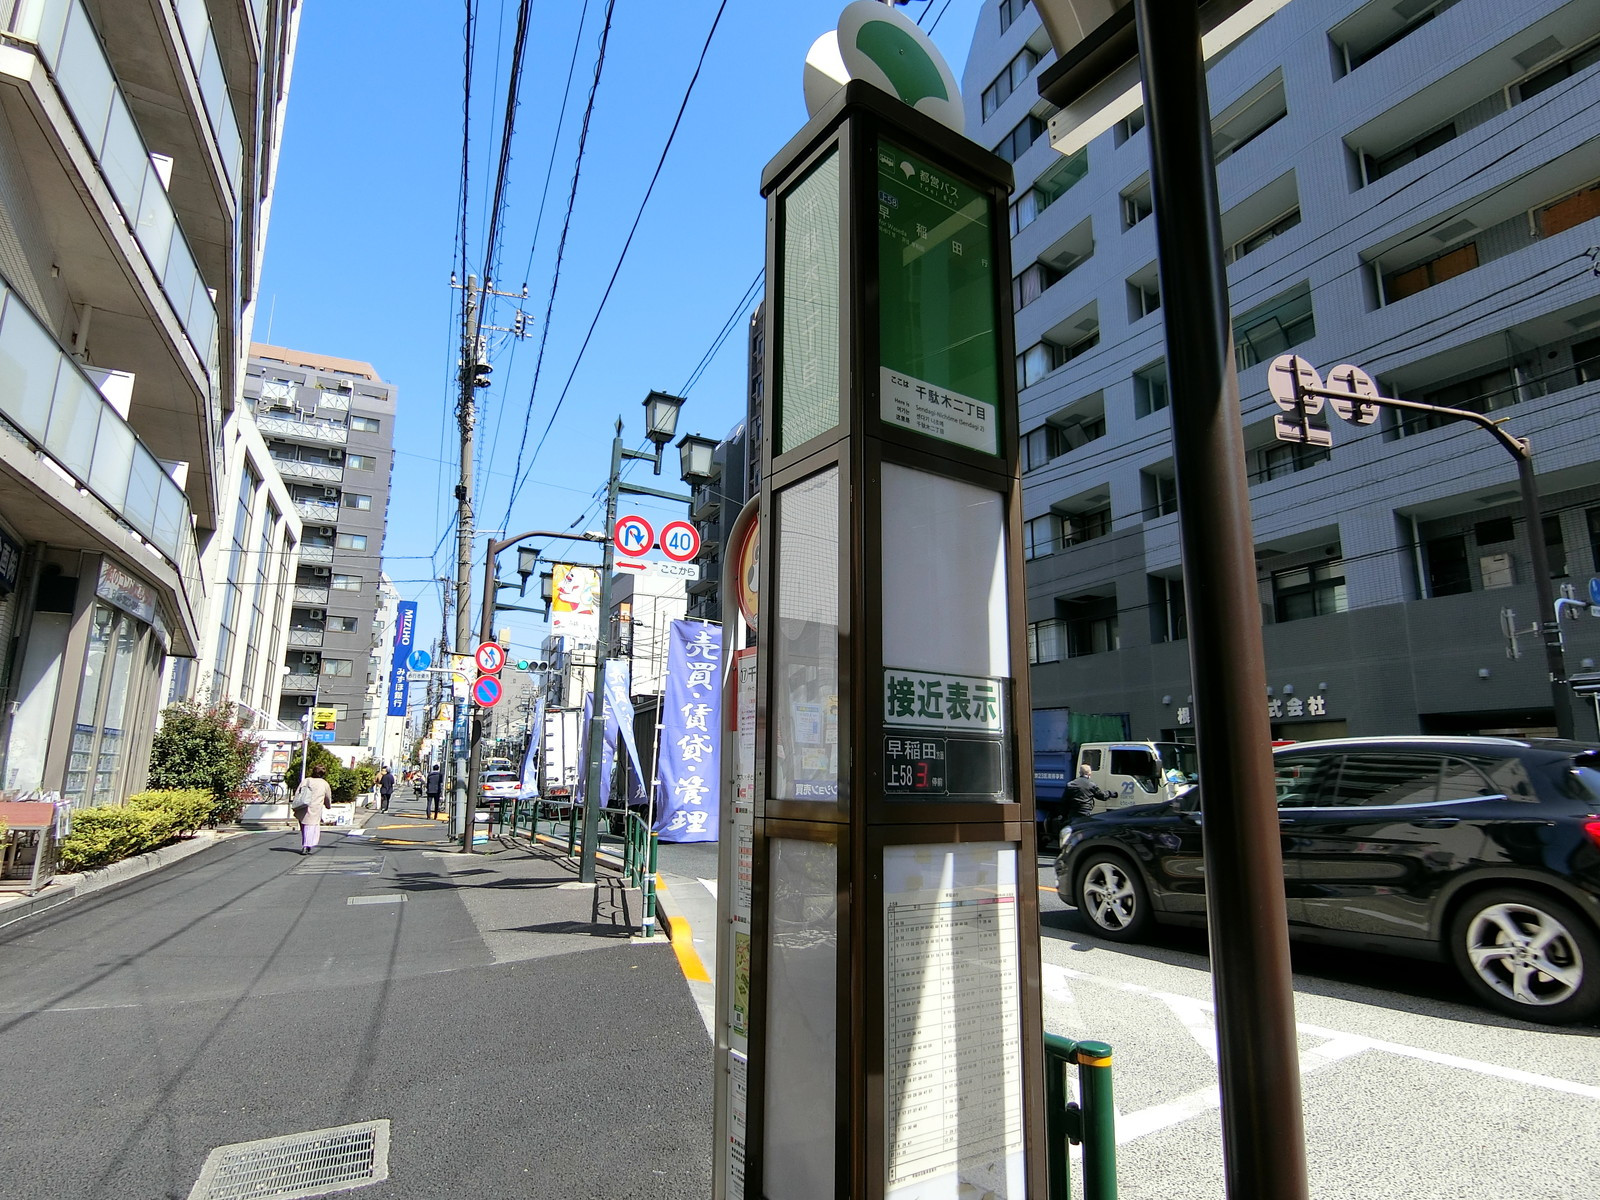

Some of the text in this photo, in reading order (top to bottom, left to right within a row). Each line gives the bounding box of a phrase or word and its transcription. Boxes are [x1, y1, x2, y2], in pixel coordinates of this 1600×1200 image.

[920, 170, 959, 199] 都営バス
[891, 375, 986, 421] ここは 千駄木二丁目
[669, 532, 691, 551] 40
[661, 564, 696, 577] ここから
[402, 609, 414, 646] MIZUHO
[887, 676, 997, 723] 接近表示
[667, 630, 720, 834] 売買・賃貸・管理
[887, 764, 913, 786] 上58
[915, 762, 928, 788] 3
[1121, 781, 1135, 795] 23
